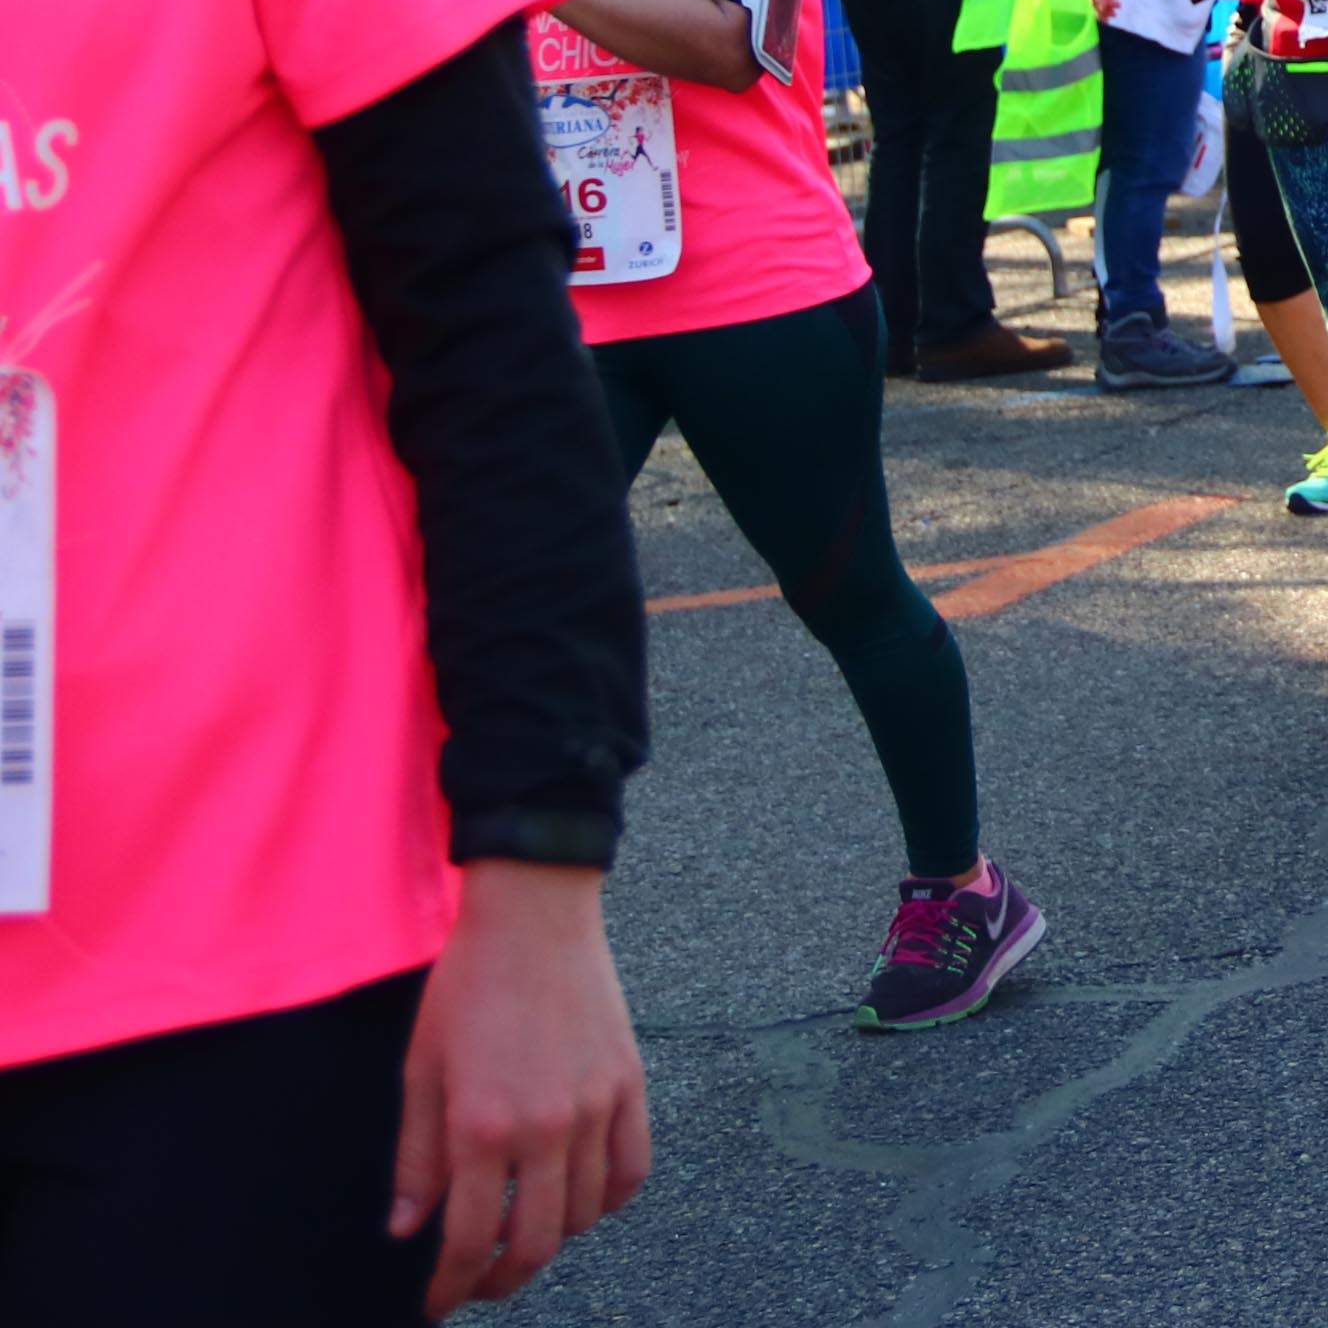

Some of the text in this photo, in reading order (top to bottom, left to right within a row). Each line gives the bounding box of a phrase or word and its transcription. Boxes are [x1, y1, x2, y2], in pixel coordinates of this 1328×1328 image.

[537, 35, 620, 73] CHIC
[549, 118, 604, 136] RIANA
[559, 177, 608, 214] 16
